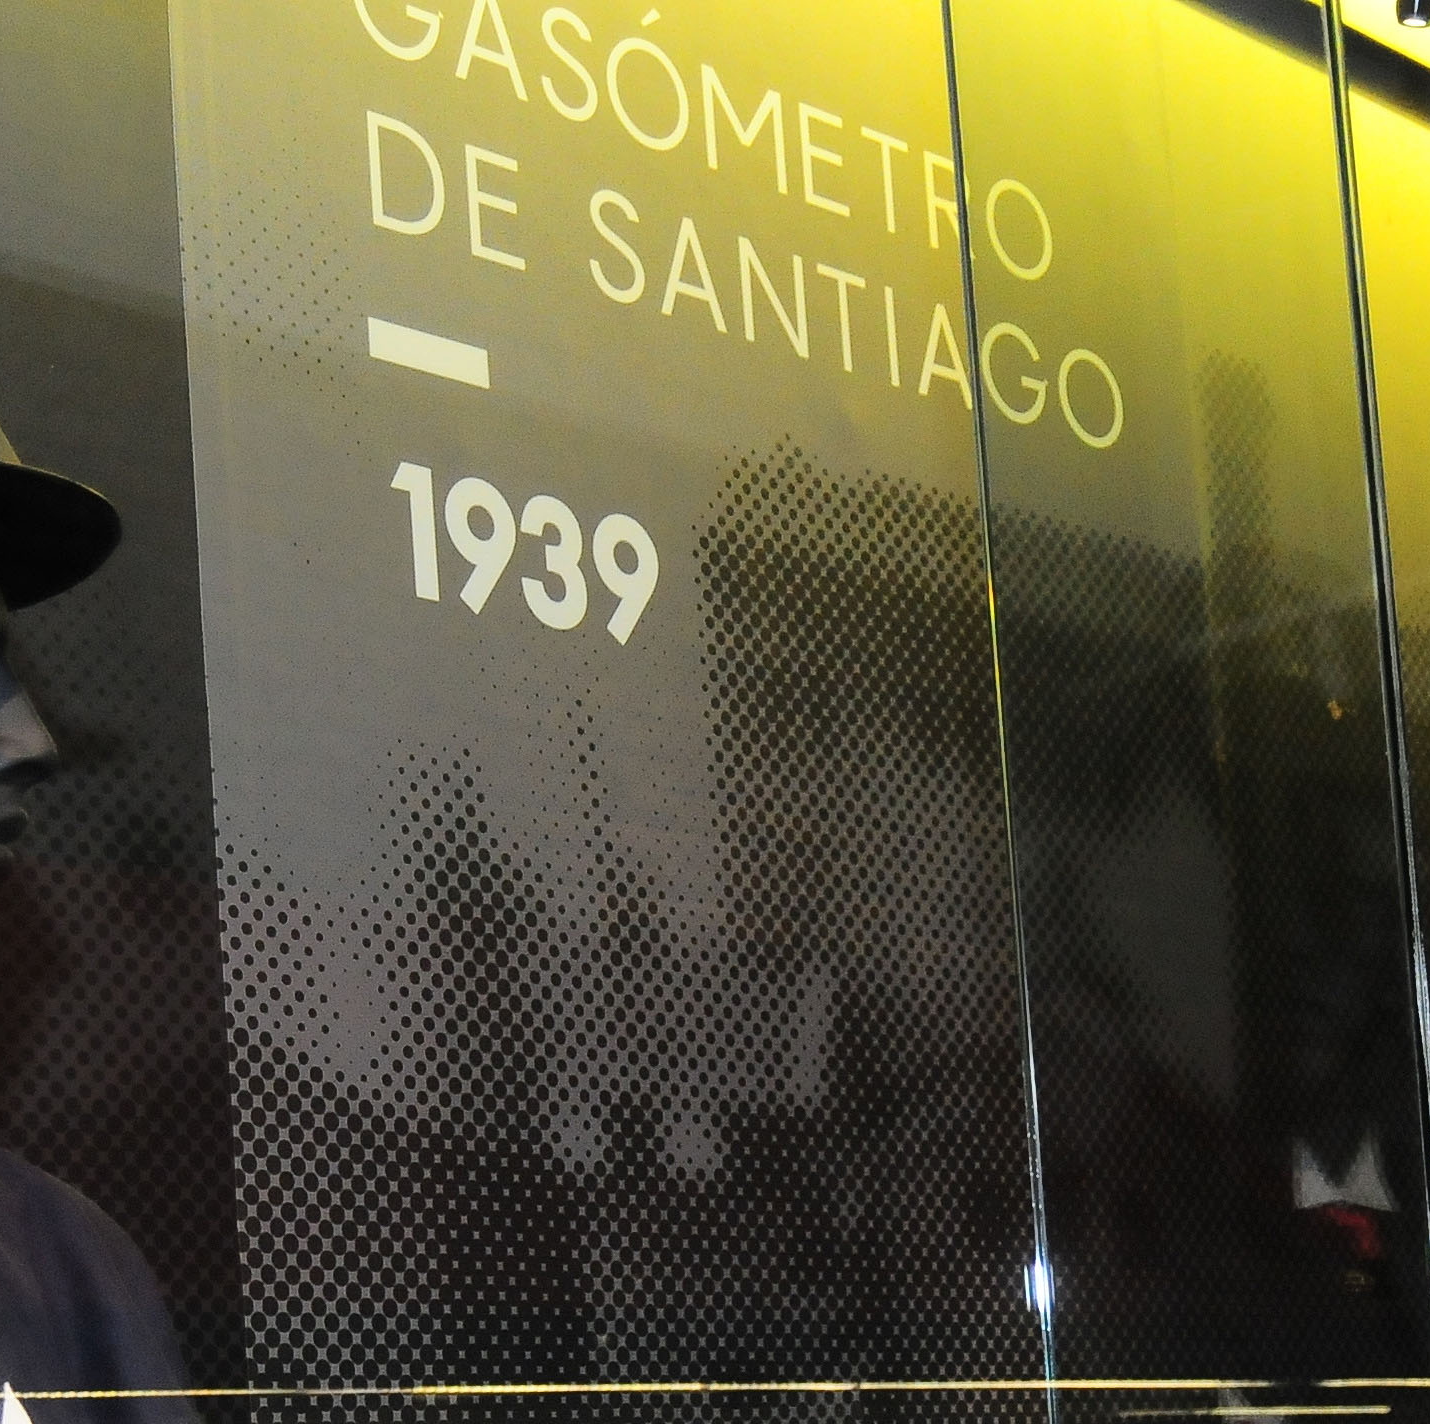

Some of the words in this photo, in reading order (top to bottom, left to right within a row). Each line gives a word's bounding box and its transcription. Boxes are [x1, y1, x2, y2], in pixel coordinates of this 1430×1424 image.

[357, 0, 1053, 281] GASÓMETRO
[366, 110, 527, 271] DE
[589, 188, 1124, 449] SANTIAGO
[390, 461, 660, 646] 1939
